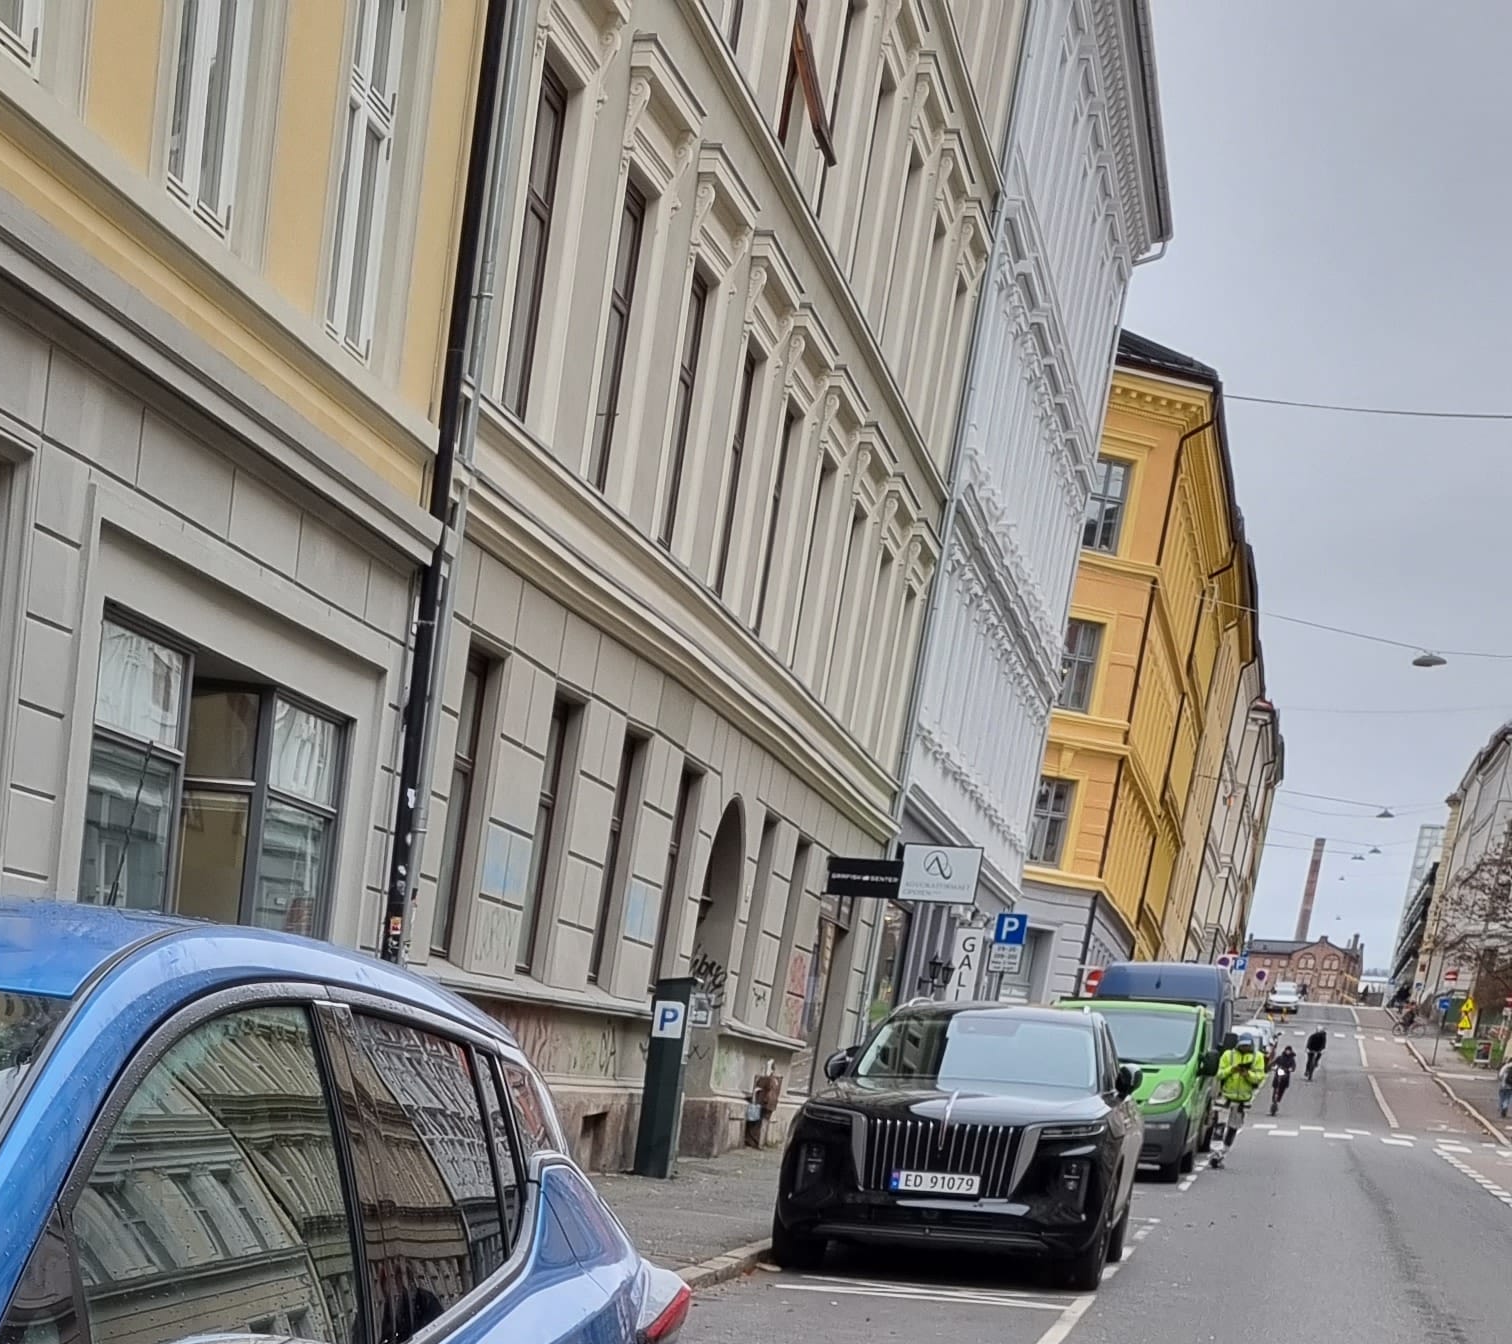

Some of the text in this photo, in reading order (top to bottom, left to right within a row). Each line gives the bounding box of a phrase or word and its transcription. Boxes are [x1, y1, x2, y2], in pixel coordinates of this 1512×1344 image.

[1001, 917, 1020, 941] P
[658, 1007, 679, 1031] P
[904, 1173, 974, 1191] ED 91079
